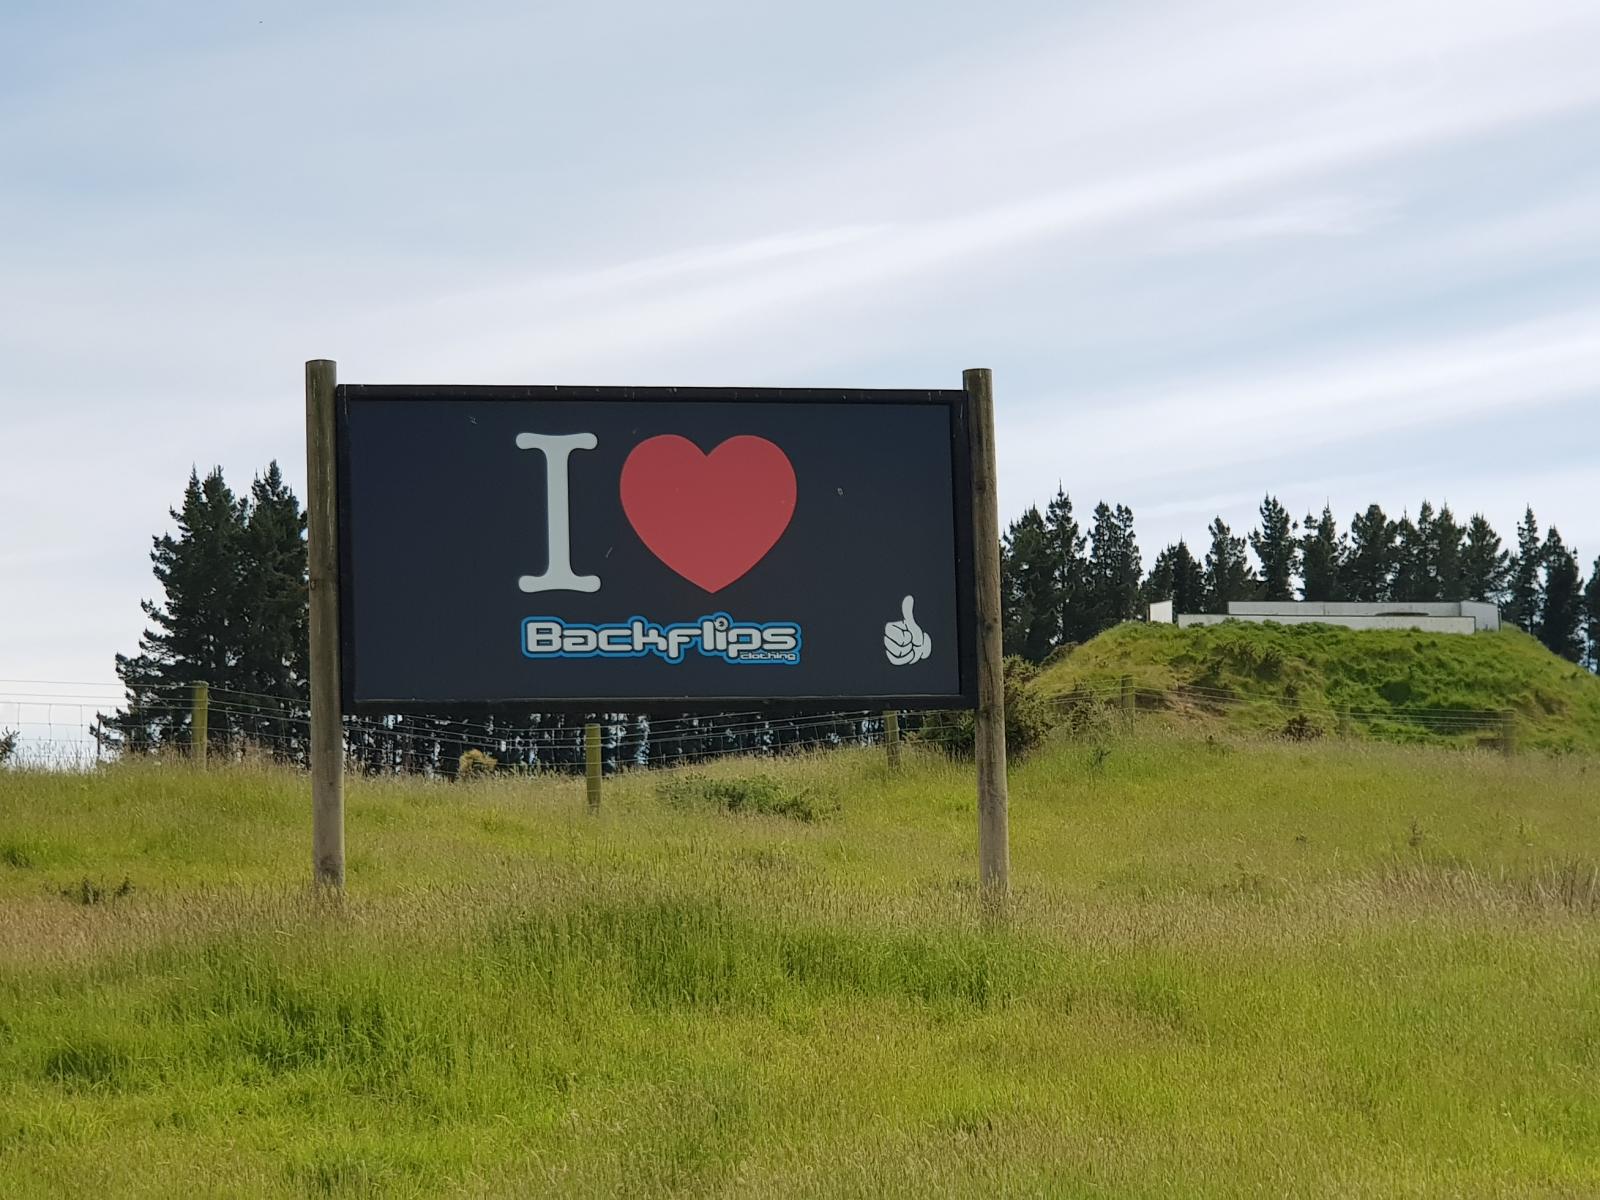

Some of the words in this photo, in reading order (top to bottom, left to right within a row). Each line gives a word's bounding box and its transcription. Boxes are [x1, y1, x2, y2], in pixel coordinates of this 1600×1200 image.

[515, 432, 601, 593] I
[525, 616, 797, 659] Backflips
[740, 651, 796, 661] clothing
